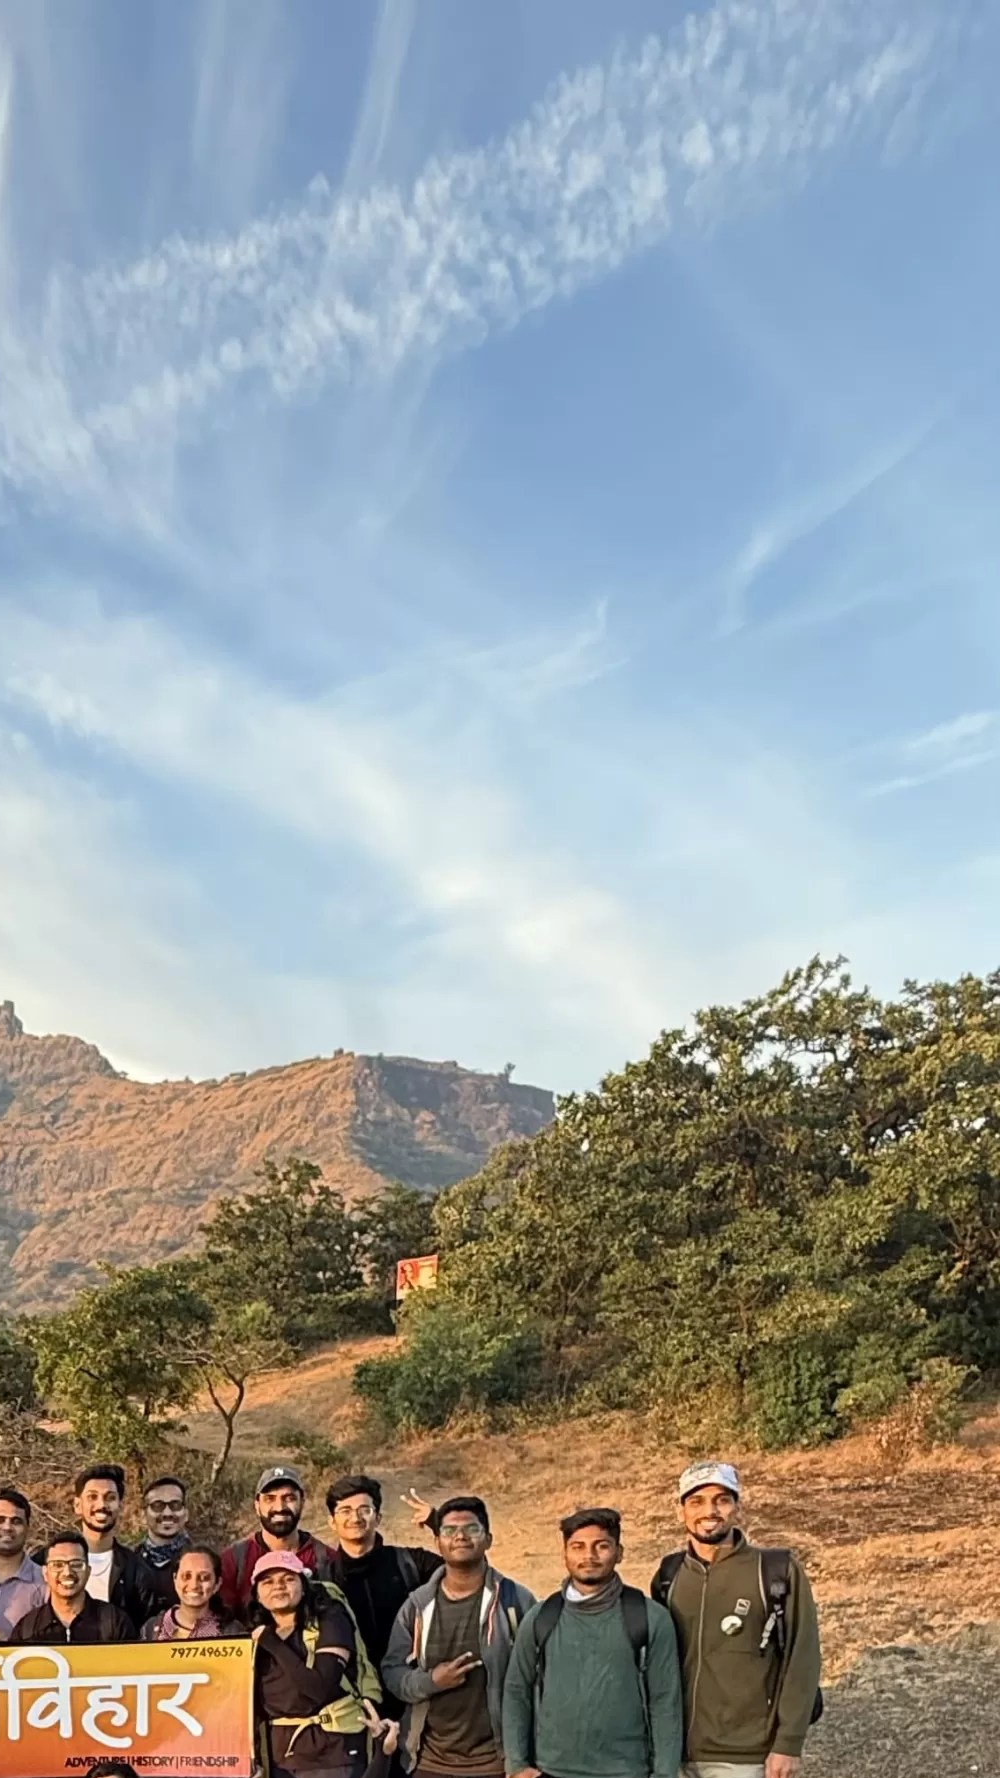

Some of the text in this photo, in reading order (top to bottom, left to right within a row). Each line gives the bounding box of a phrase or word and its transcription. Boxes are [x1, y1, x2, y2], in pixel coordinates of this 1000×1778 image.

[171, 1646, 243, 1658] 7977496576
[132, 1756, 174, 1767] HISTORY
[180, 1756, 239, 1768] FRIENDSHIP
